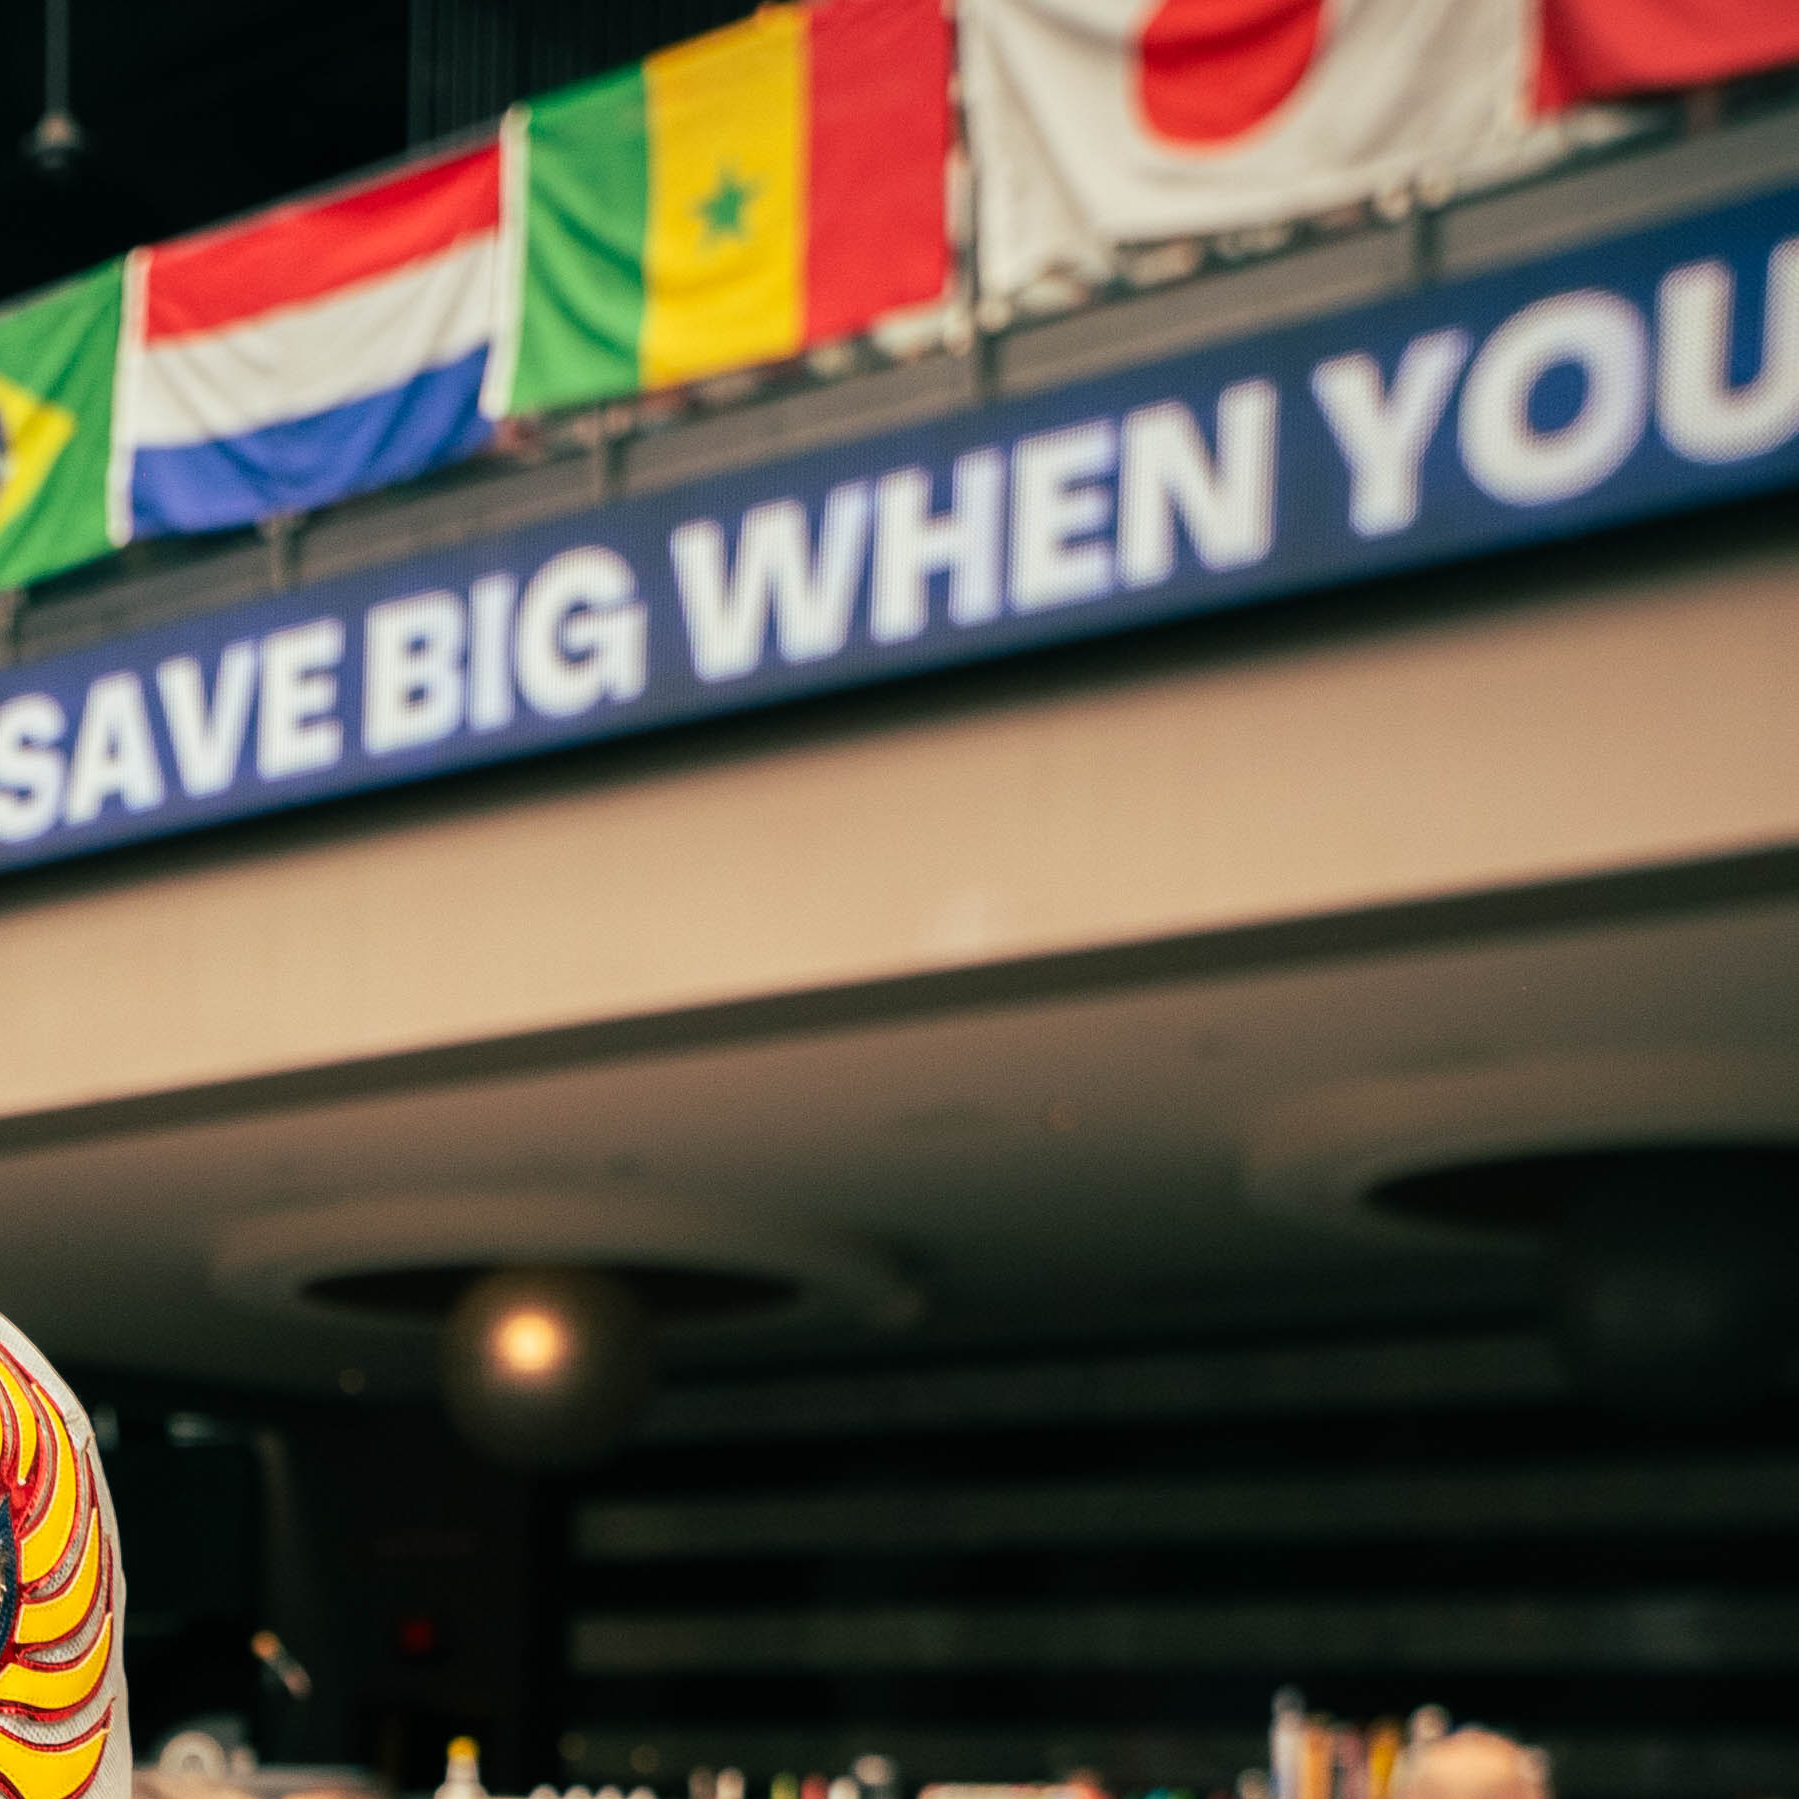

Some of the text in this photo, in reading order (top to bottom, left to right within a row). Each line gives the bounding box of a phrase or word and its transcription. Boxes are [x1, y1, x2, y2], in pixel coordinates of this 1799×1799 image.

[364, 547, 648, 754] BIG
[671, 378, 1278, 683] WHEN
[1310, 236, 1799, 539] YOU
